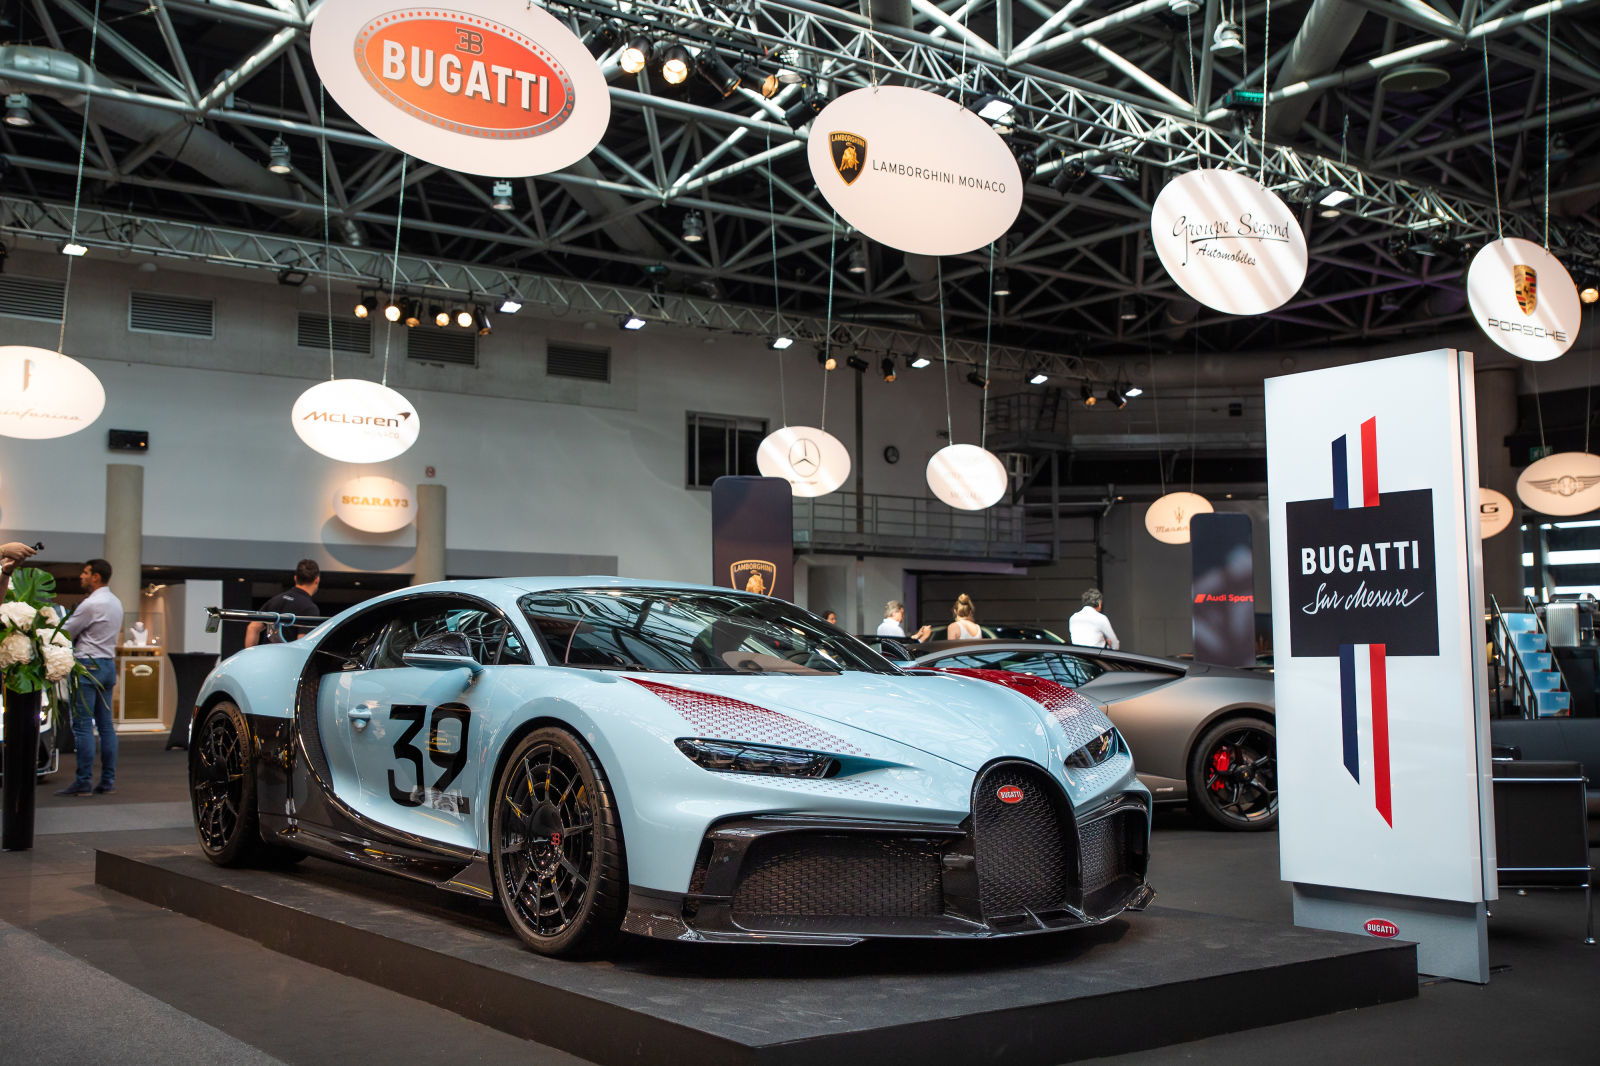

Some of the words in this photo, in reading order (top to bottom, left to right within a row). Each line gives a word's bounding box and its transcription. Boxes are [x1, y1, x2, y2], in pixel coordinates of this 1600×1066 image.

[382, 39, 549, 115] BUGATTI
[831, 133, 865, 148] LAMBORGHINI
[872, 159, 954, 185] LAMBORGHINI
[958, 175, 1006, 194] MONACO
[1172, 215, 1230, 266] Groupe
[1196, 243, 1256, 266] Automobiles
[1488, 318, 1567, 342] PORSCHE
[302, 410, 399, 428] McLaren
[341, 495, 409, 508] SCARA73
[734, 562, 773, 573] LAMBORGHINI
[1301, 540, 1419, 575] BUGATTI
[1206, 593, 1227, 602] Audi
[1228, 593, 1254, 604] Sport
[1302, 582, 1344, 615] Sur
[1344, 580, 1424, 611] Mesure
[1367, 923, 1396, 934] BUGATTI
